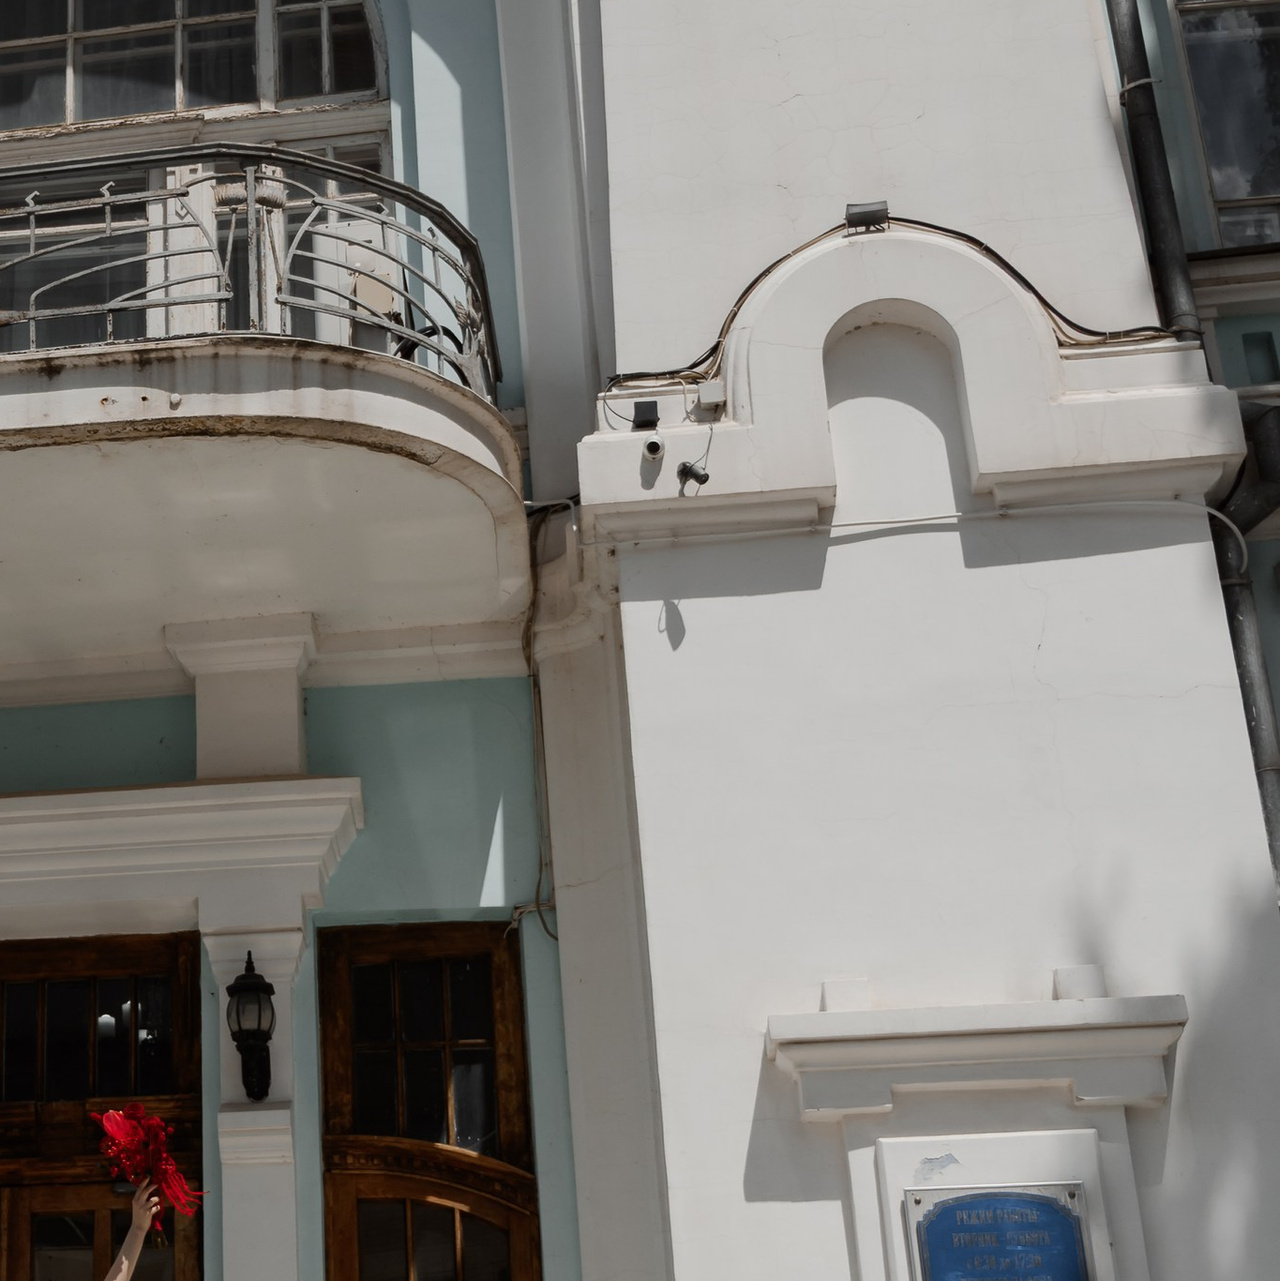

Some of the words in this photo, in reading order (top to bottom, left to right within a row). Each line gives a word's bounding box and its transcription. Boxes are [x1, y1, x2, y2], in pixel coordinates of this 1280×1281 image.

[956, 1210, 995, 1226] РЕЖИМ
[951, 1231, 1000, 1248] ВТОРНИК
[999, 1257, 1012, 1271] до
[1014, 1253, 1043, 1269] 17:30
